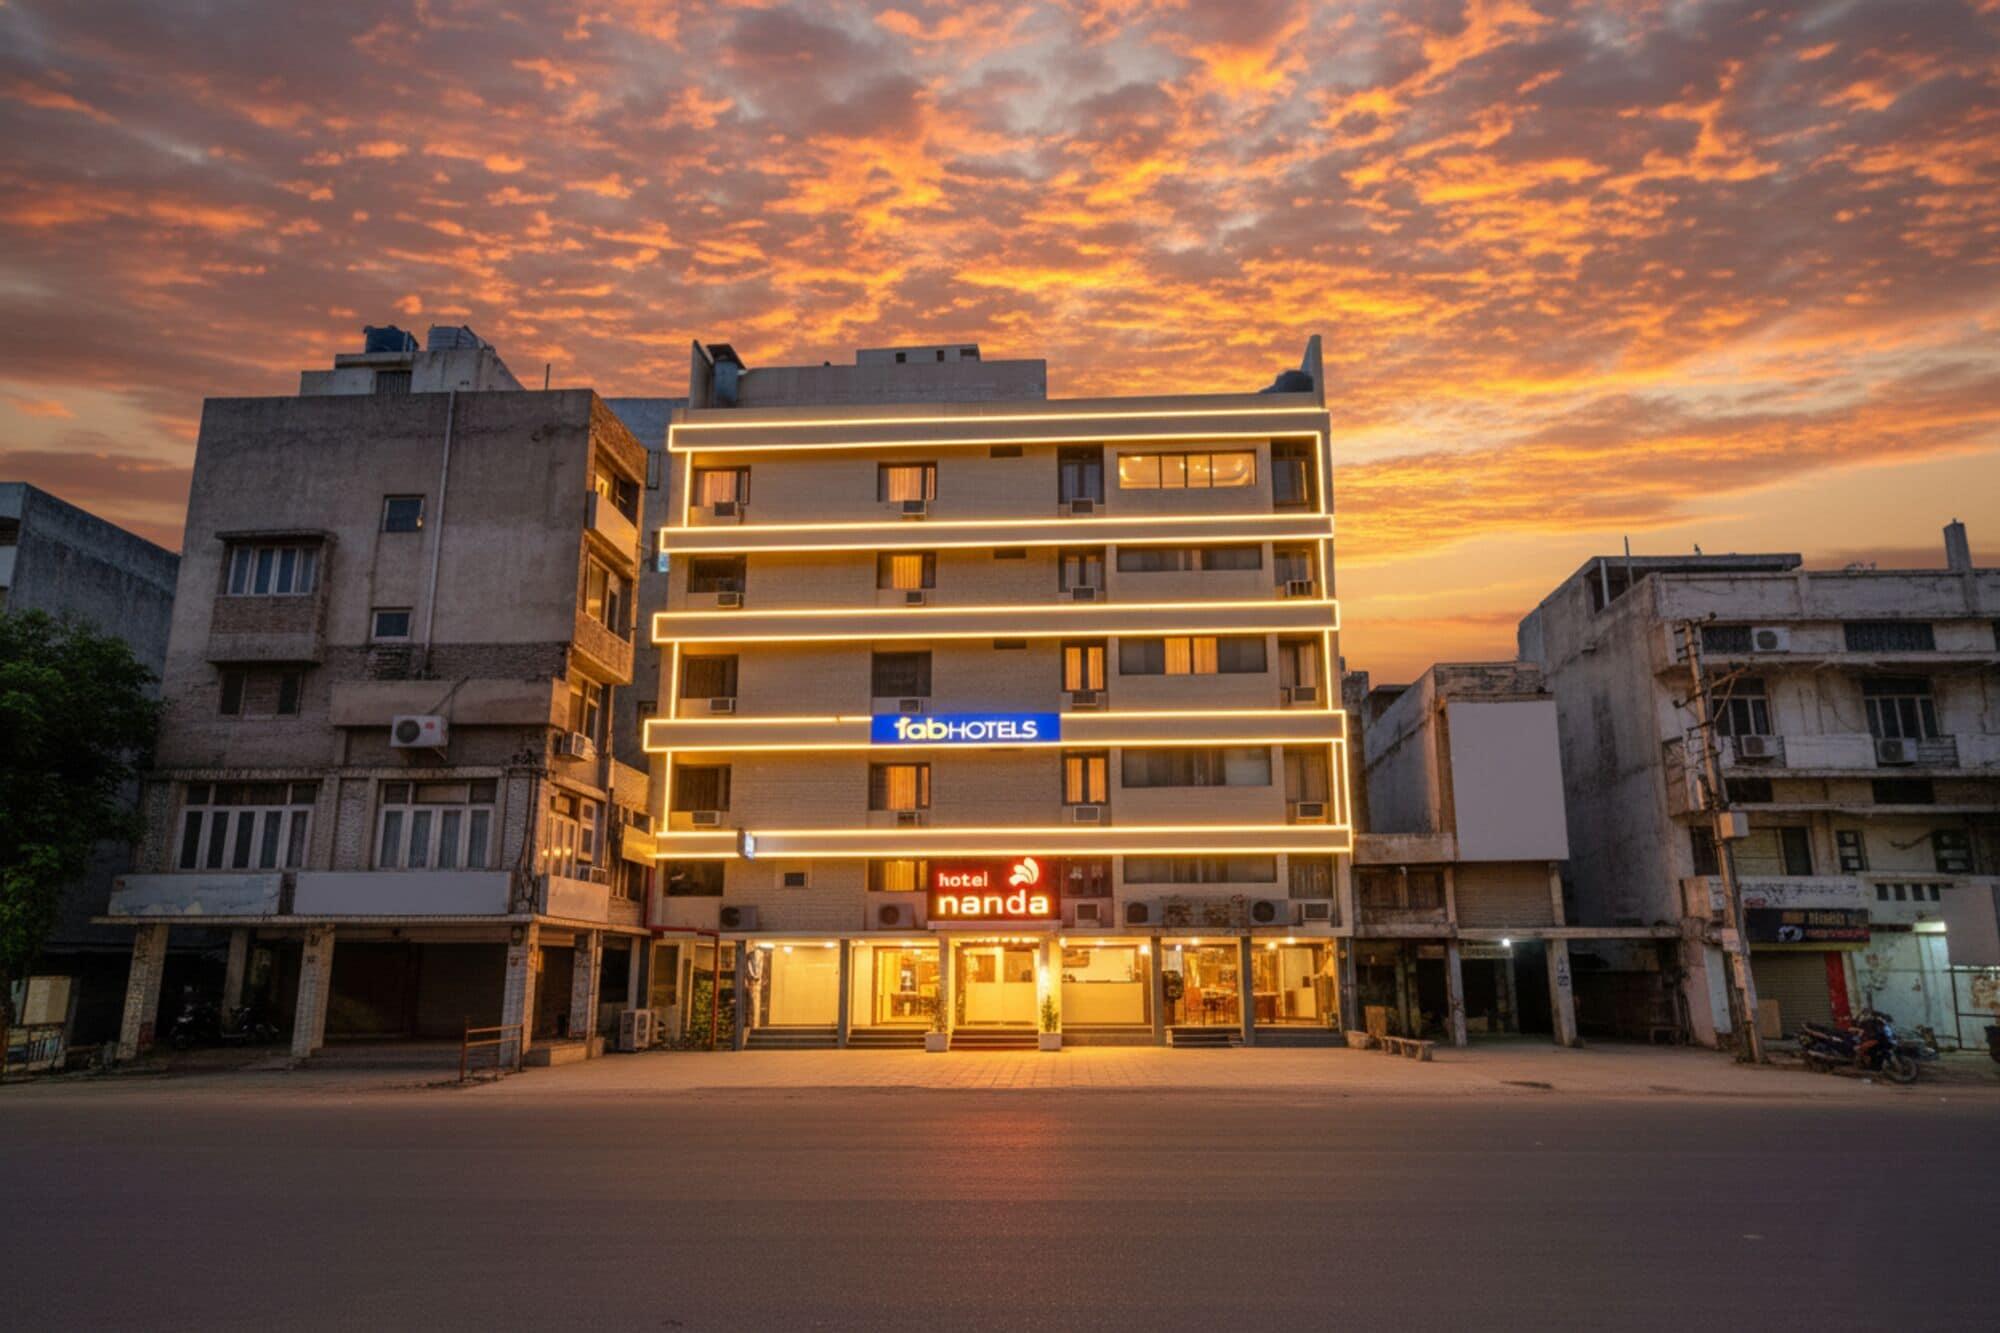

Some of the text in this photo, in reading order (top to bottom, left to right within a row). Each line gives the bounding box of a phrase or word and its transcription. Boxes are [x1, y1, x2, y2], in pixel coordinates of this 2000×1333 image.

[894, 717, 1038, 740] fabHOTELS
[939, 871, 988, 887] hotel
[938, 889, 1049, 915] nanda
